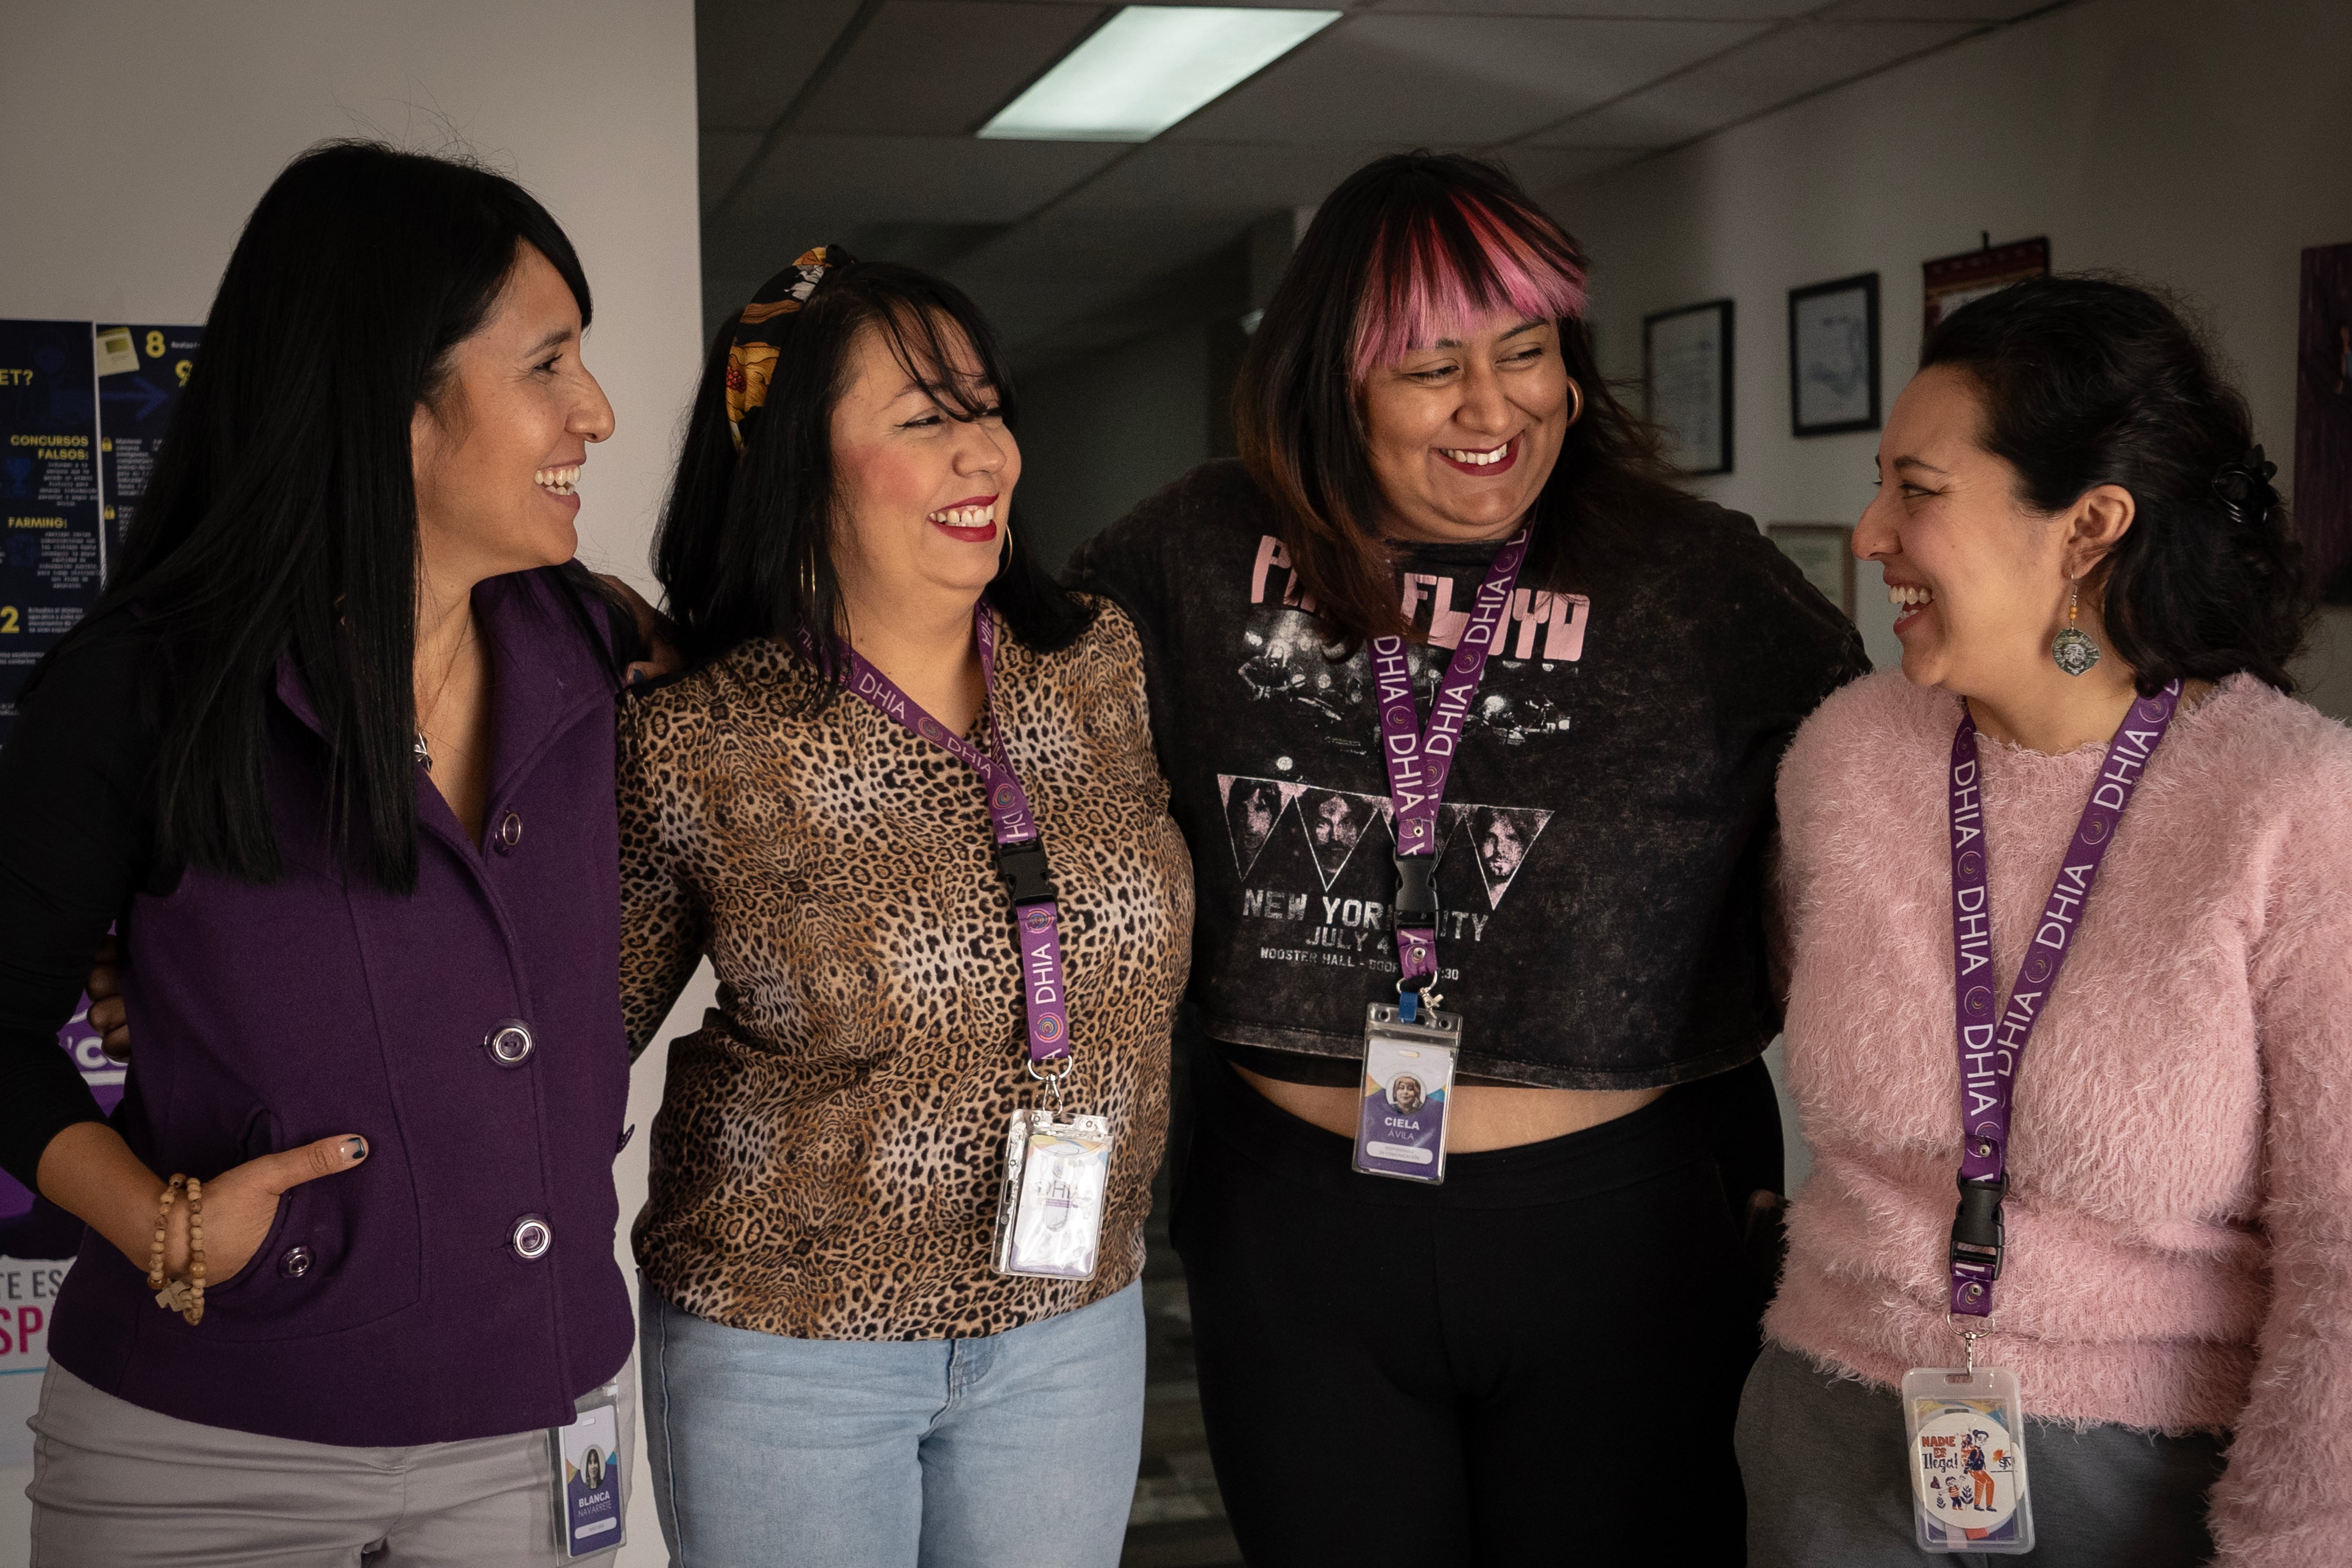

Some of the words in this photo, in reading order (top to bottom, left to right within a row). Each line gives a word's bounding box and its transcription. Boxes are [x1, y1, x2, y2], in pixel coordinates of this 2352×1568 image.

[145, 330, 166, 358] 8
[0, 369, 33, 386] ET?
[10, 435, 89, 447] CONCURSOS
[0, 605, 19, 634] 2
[1464, 576, 1511, 644] DHIA
[1374, 636, 1408, 703] DHIA
[858, 672, 905, 719] DHIA
[1424, 685, 1473, 756] DHIA
[947, 736, 991, 780] DHIA
[1389, 733, 1425, 813] DHIA
[2093, 730, 2159, 810] DHIA
[1955, 759, 1980, 848] DHIA
[1242, 888, 1308, 921] NEW
[2036, 864, 2093, 949] DHIA
[1305, 926, 1368, 951] JULY
[1958, 886, 1989, 976] DHIA
[1031, 943, 1056, 1004] DHIA
[1261, 947, 1318, 963] WOOSTER
[1322, 953, 1355, 967] HALL
[1964, 1024, 1998, 1116] DHIA
[1384, 1117, 1420, 1130] CIELA
[1922, 1436, 1955, 1447] NADIE
[1933, 1447, 1947, 1458] ES
[578, 1500, 612, 1518] NAVARRETE
[579, 1490, 610, 1507] BLANCA
